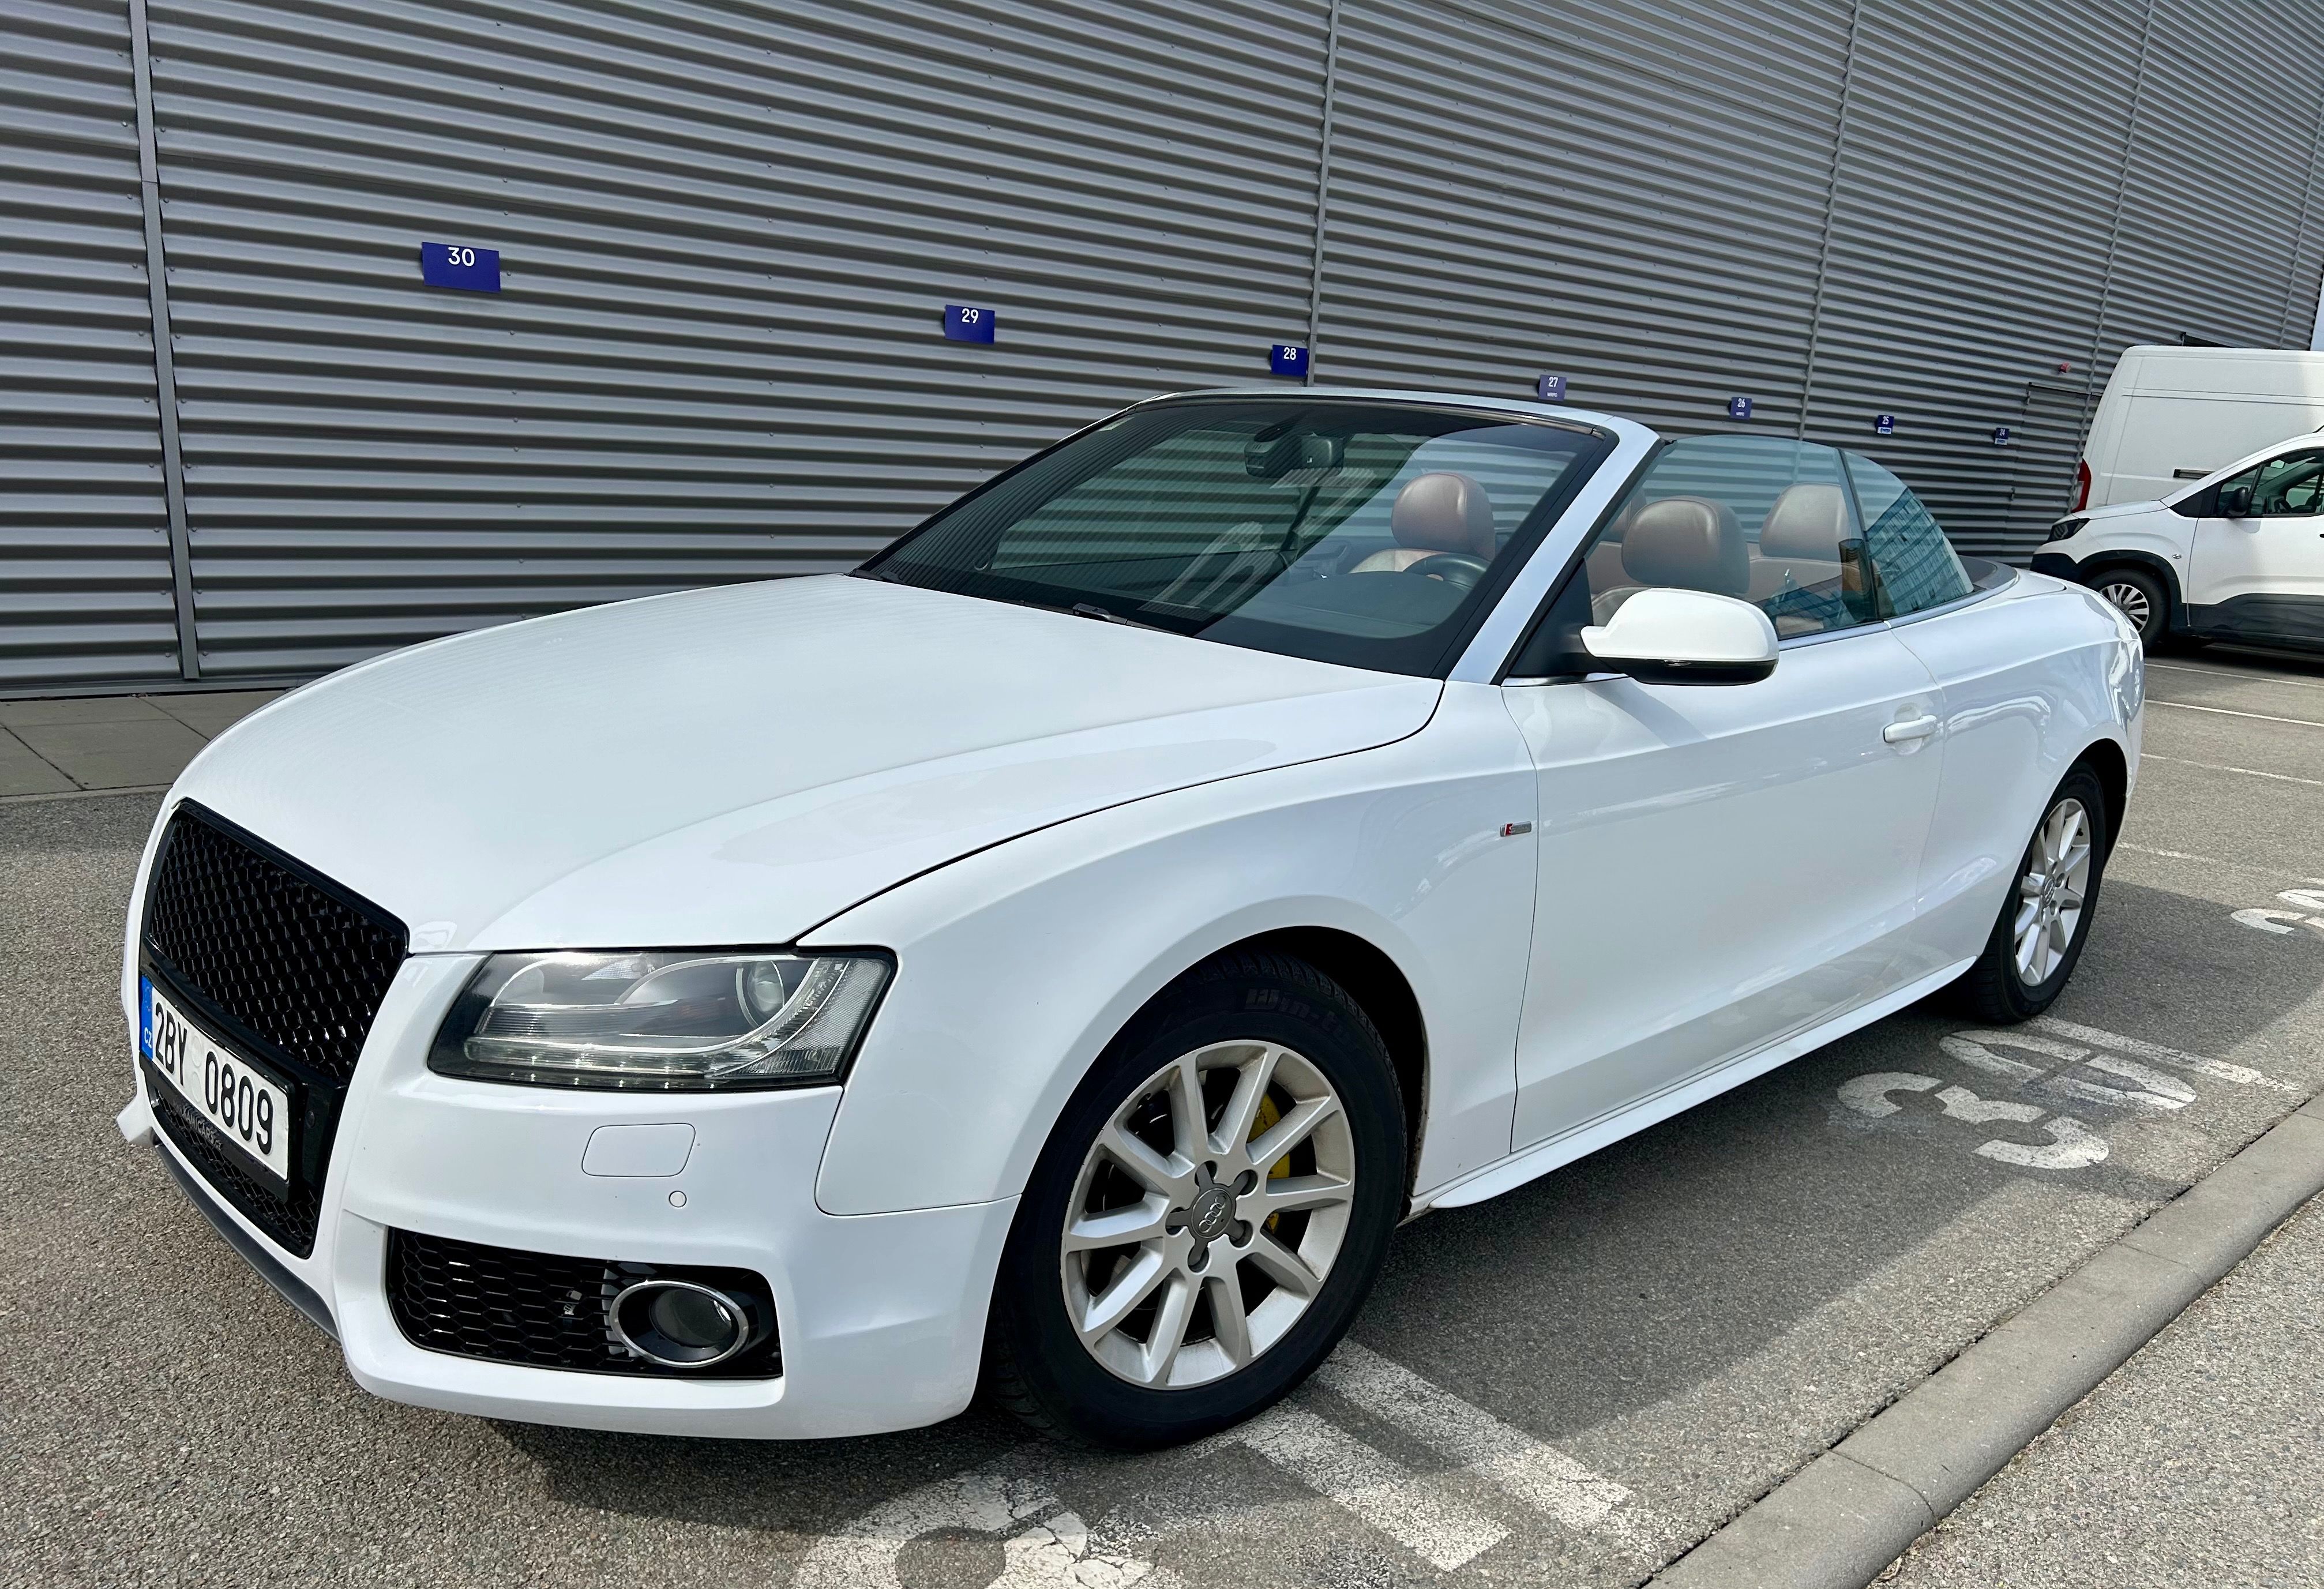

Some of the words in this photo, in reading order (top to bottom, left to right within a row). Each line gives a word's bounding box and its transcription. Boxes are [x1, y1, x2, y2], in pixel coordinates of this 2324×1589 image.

[448, 247, 475, 266] 30
[962, 308, 979, 324] 29
[1283, 347, 1297, 360] 28
[1549, 377, 1559, 388] 27
[1737, 398, 1745, 408] 26
[1882, 416, 1889, 425] 25
[144, 1027, 152, 1049] CZ
[155, 1002, 188, 1086] 2BY
[205, 1051, 274, 1155] 0809
